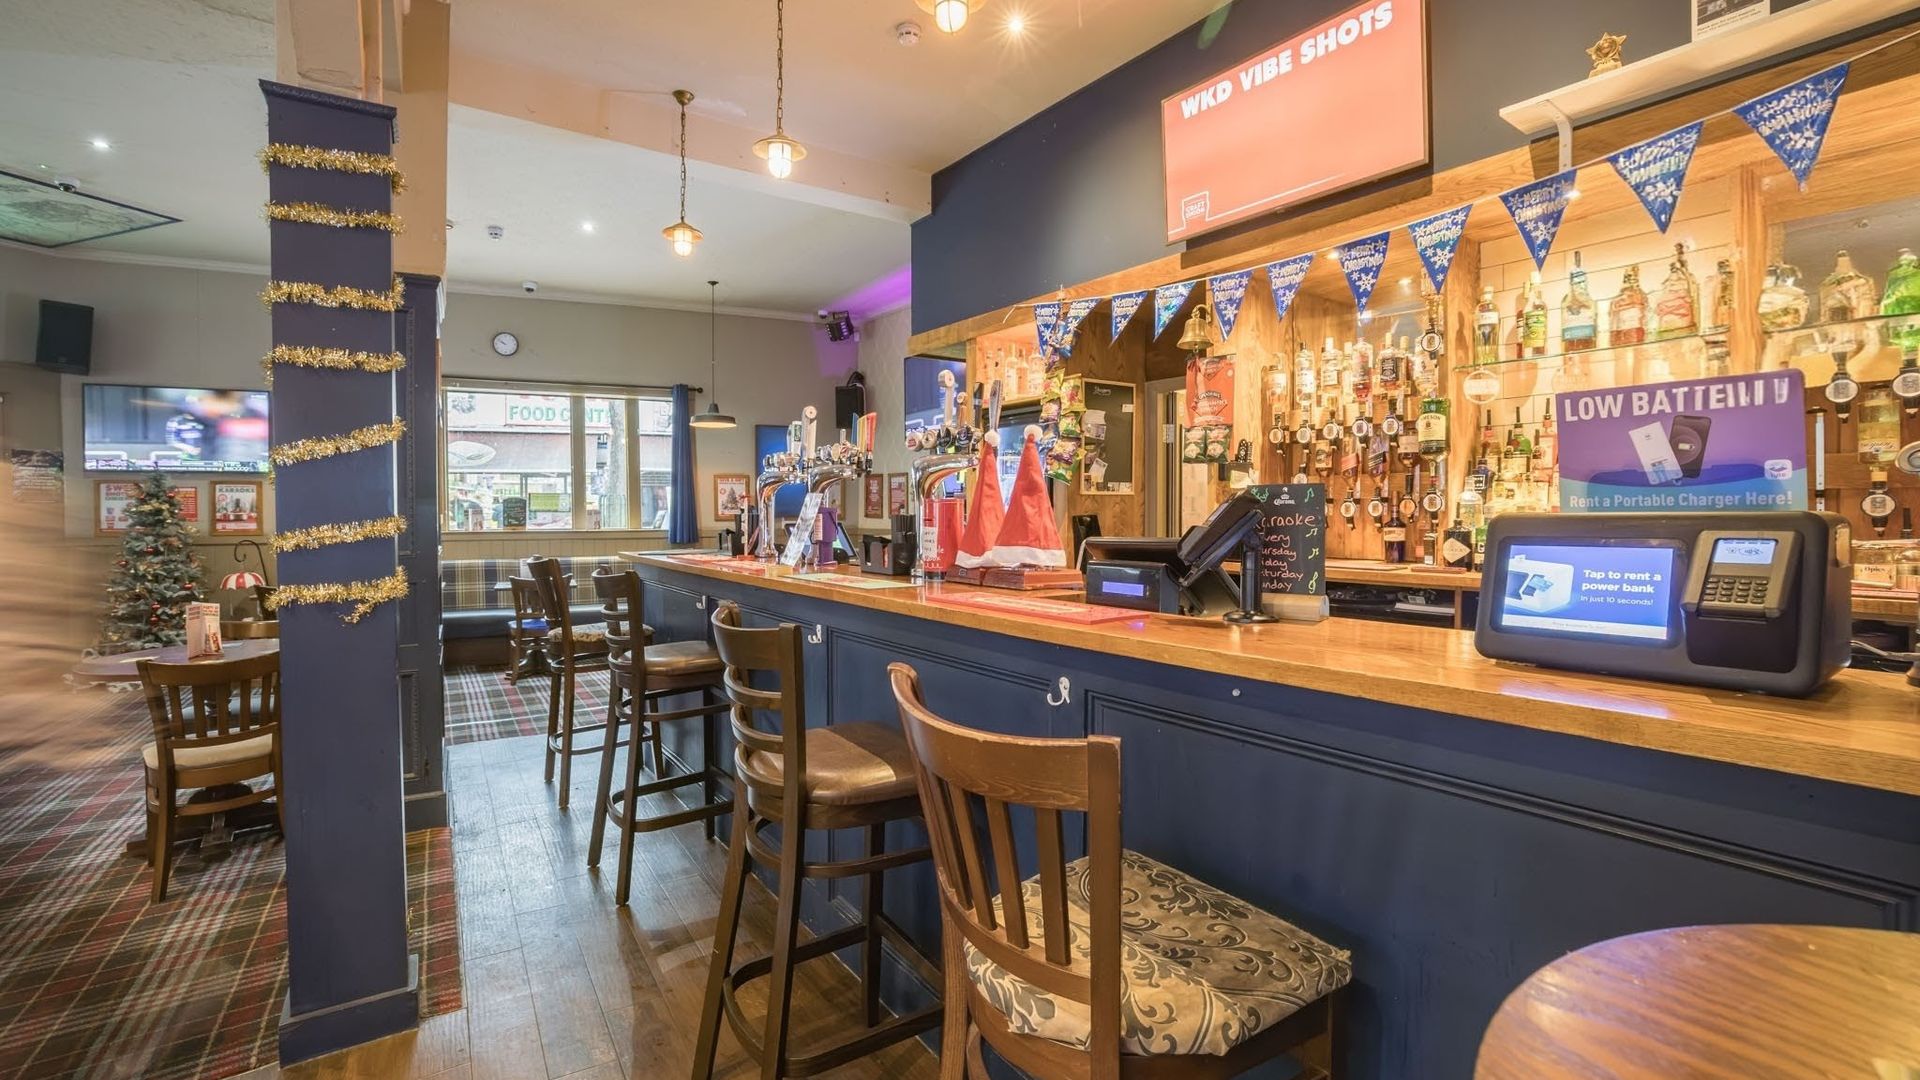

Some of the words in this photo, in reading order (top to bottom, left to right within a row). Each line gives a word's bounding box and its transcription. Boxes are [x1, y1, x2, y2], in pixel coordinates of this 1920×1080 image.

[1181, 79, 1233, 120] WKD
[1239, 49, 1293, 92] VIBE
[1299, 1, 1393, 65] SHOTS
[508, 404, 556, 422] FOOD
[1564, 394, 1624, 423] LOW
[1570, 495, 1600, 508] Rent
[1603, 498, 1611, 508] a
[1614, 493, 1675, 508] Portable
[1678, 491, 1740, 508] Charger
[1745, 490, 1793, 506] Here!
[1261, 547, 1297, 561] ursday
[1261, 558, 1288, 570] iday
[1583, 569, 1606, 580] Tap
[1609, 570, 1621, 579] to
[1624, 571, 1651, 581] rent
[1653, 573, 1662, 581] a
[1581, 582, 1620, 593] power
[1623, 582, 1655, 594] bank
[1617, 598, 1654, 606] seconds!
